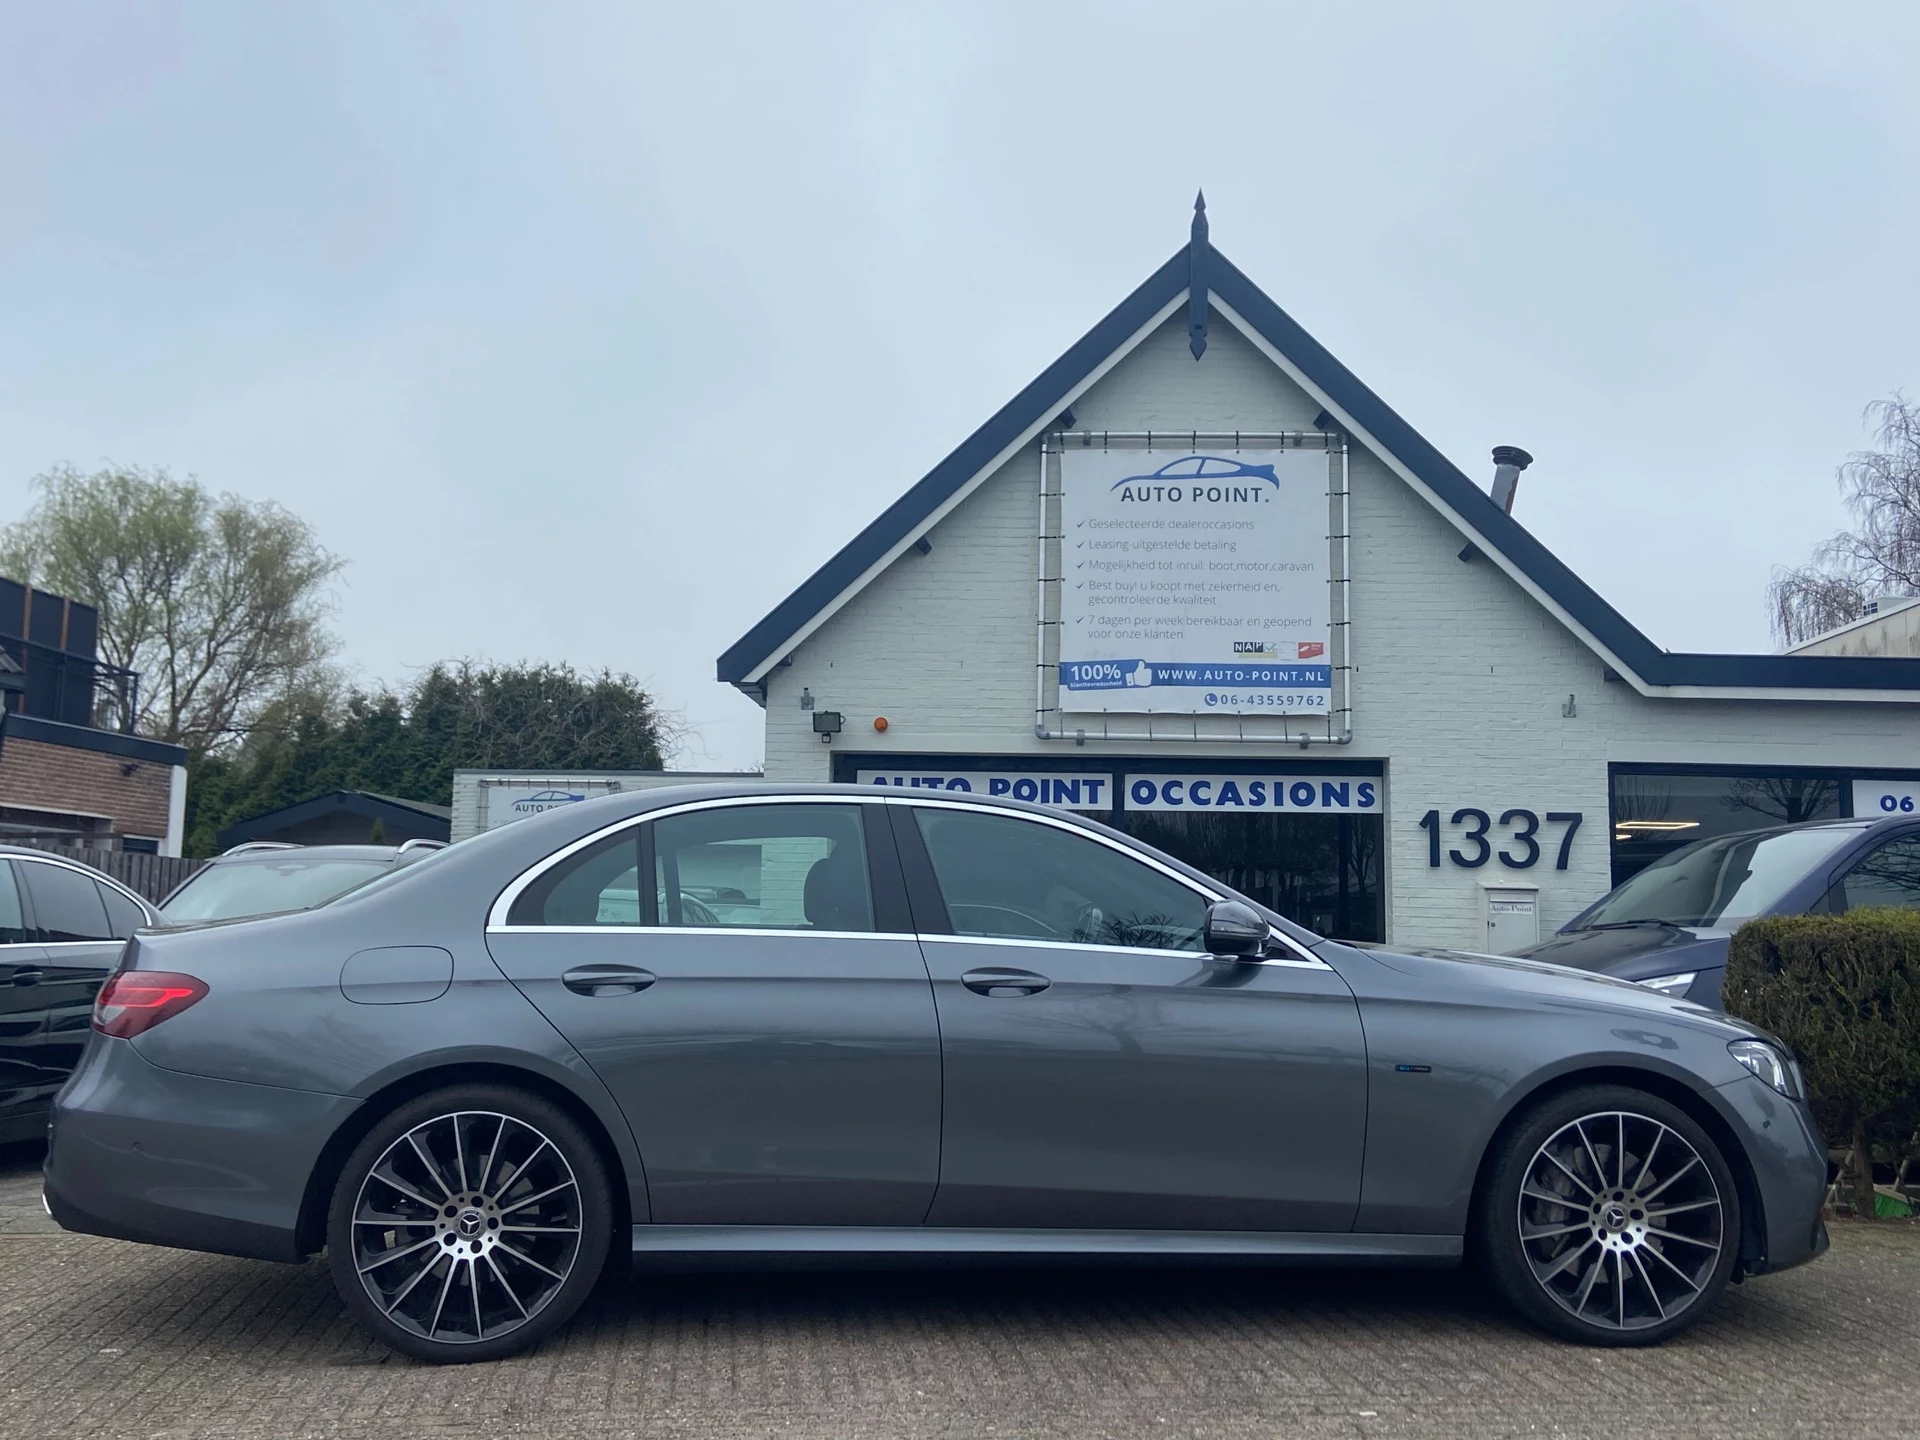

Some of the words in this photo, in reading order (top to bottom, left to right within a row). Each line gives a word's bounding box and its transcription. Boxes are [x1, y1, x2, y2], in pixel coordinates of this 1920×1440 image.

[1120, 487, 1182, 503] AUTO
[1088, 519, 1166, 530] Geselecteerde
[1168, 519, 1255, 530] dealeroccasions
[1088, 540, 1192, 552] Leasing-uitgestelde
[1194, 540, 1238, 553] betaling
[1088, 559, 1155, 573] Mogelijkheid
[1158, 561, 1174, 571] tot
[1209, 560, 1315, 573] boot,motor,caravan
[1088, 580, 1113, 591] Best
[1115, 580, 1138, 593] buy!
[1140, 583, 1148, 591] u
[1150, 581, 1182, 594] koopt
[1184, 583, 1206, 592] met
[1208, 582, 1261, 593] zekerheid
[1088, 594, 1171, 607] gecontroleerde
[1173, 595, 1217, 606] kwaliteit
[1088, 614, 1096, 624] 7
[1098, 615, 1132, 628] dagen
[1134, 617, 1153, 627] per
[1155, 616, 1184, 626] week
[1186, 616, 1244, 627] bereikbaar
[1246, 619, 1261, 627] en
[1263, 617, 1312, 630] geopend
[1087, 630, 1113, 640] voor
[1115, 630, 1141, 640] onze
[1144, 629, 1184, 640] klanten
[1234, 641, 1264, 653] NAP
[1070, 664, 1122, 681] 100%
[1157, 669, 1325, 683] WWW.AUTO-POINT.NL
[1220, 694, 1325, 707] 06-43559762
[989, 778, 1105, 804] POINT
[1131, 779, 1376, 808] OCCASIONS
[514, 804, 544, 813] AUTO
[1418, 808, 1583, 871] 1337
